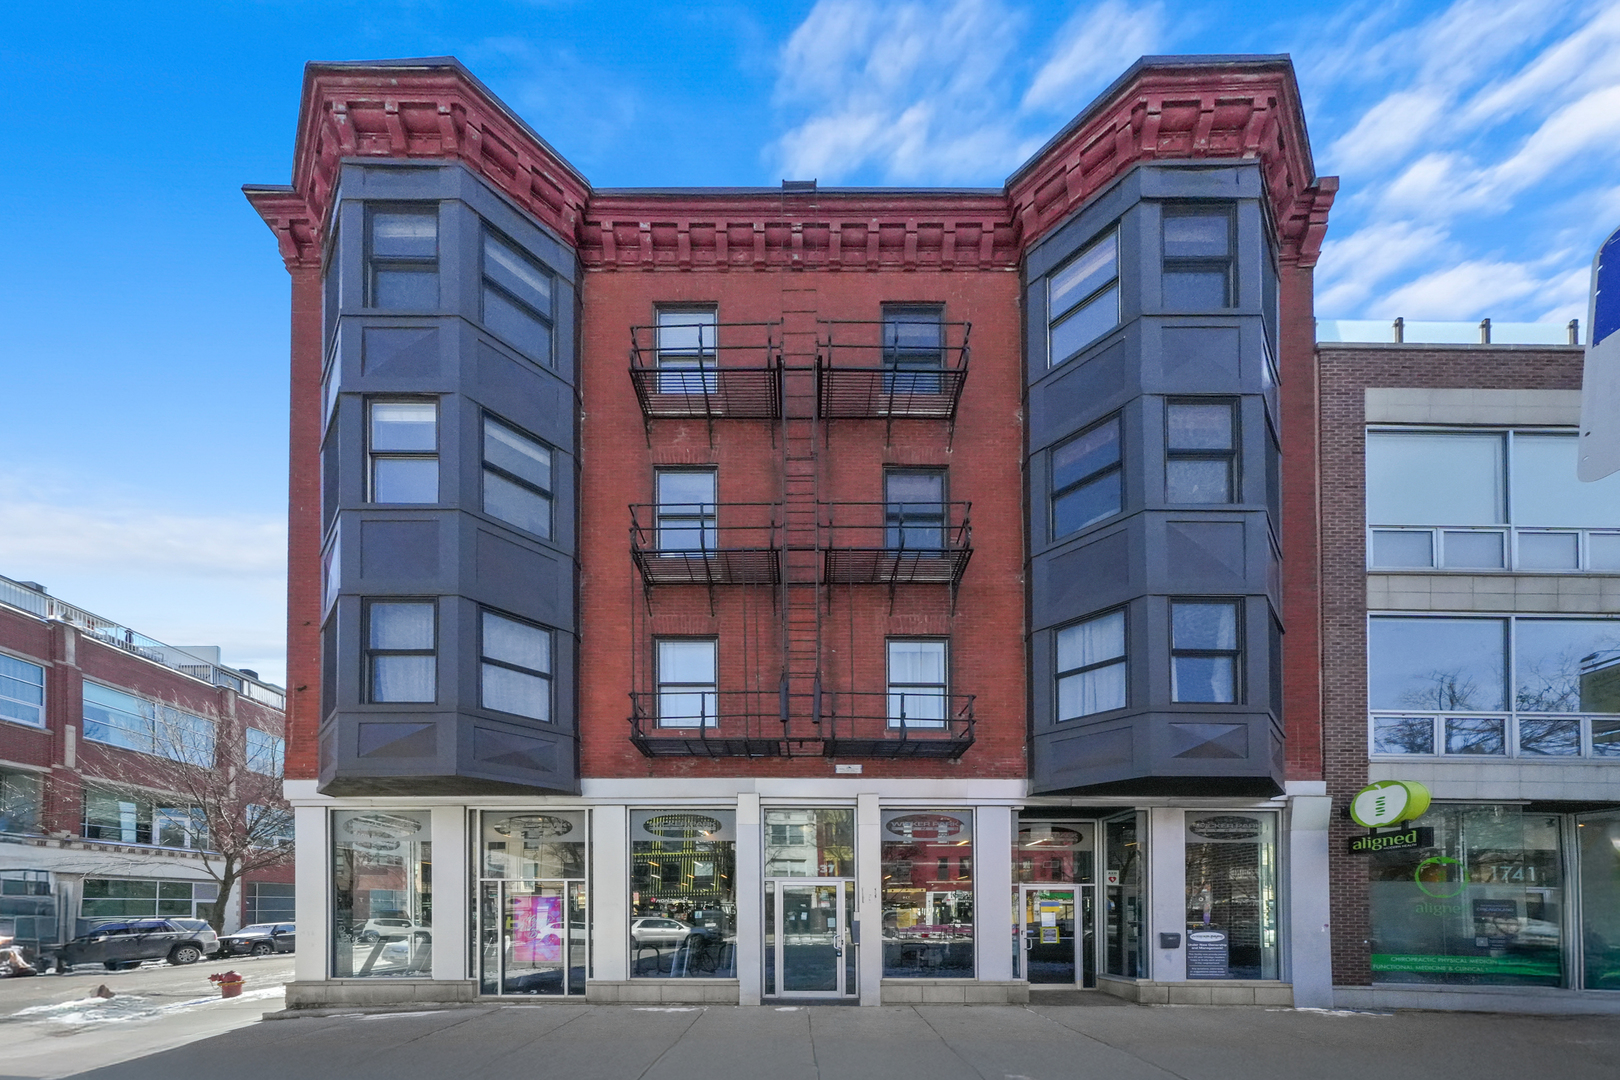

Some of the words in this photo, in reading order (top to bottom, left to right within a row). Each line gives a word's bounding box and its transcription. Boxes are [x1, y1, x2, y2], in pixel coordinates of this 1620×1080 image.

[1352, 830, 1417, 851] aligned
[1491, 866, 1535, 882] 1741
[1415, 902, 1469, 916] aligne
